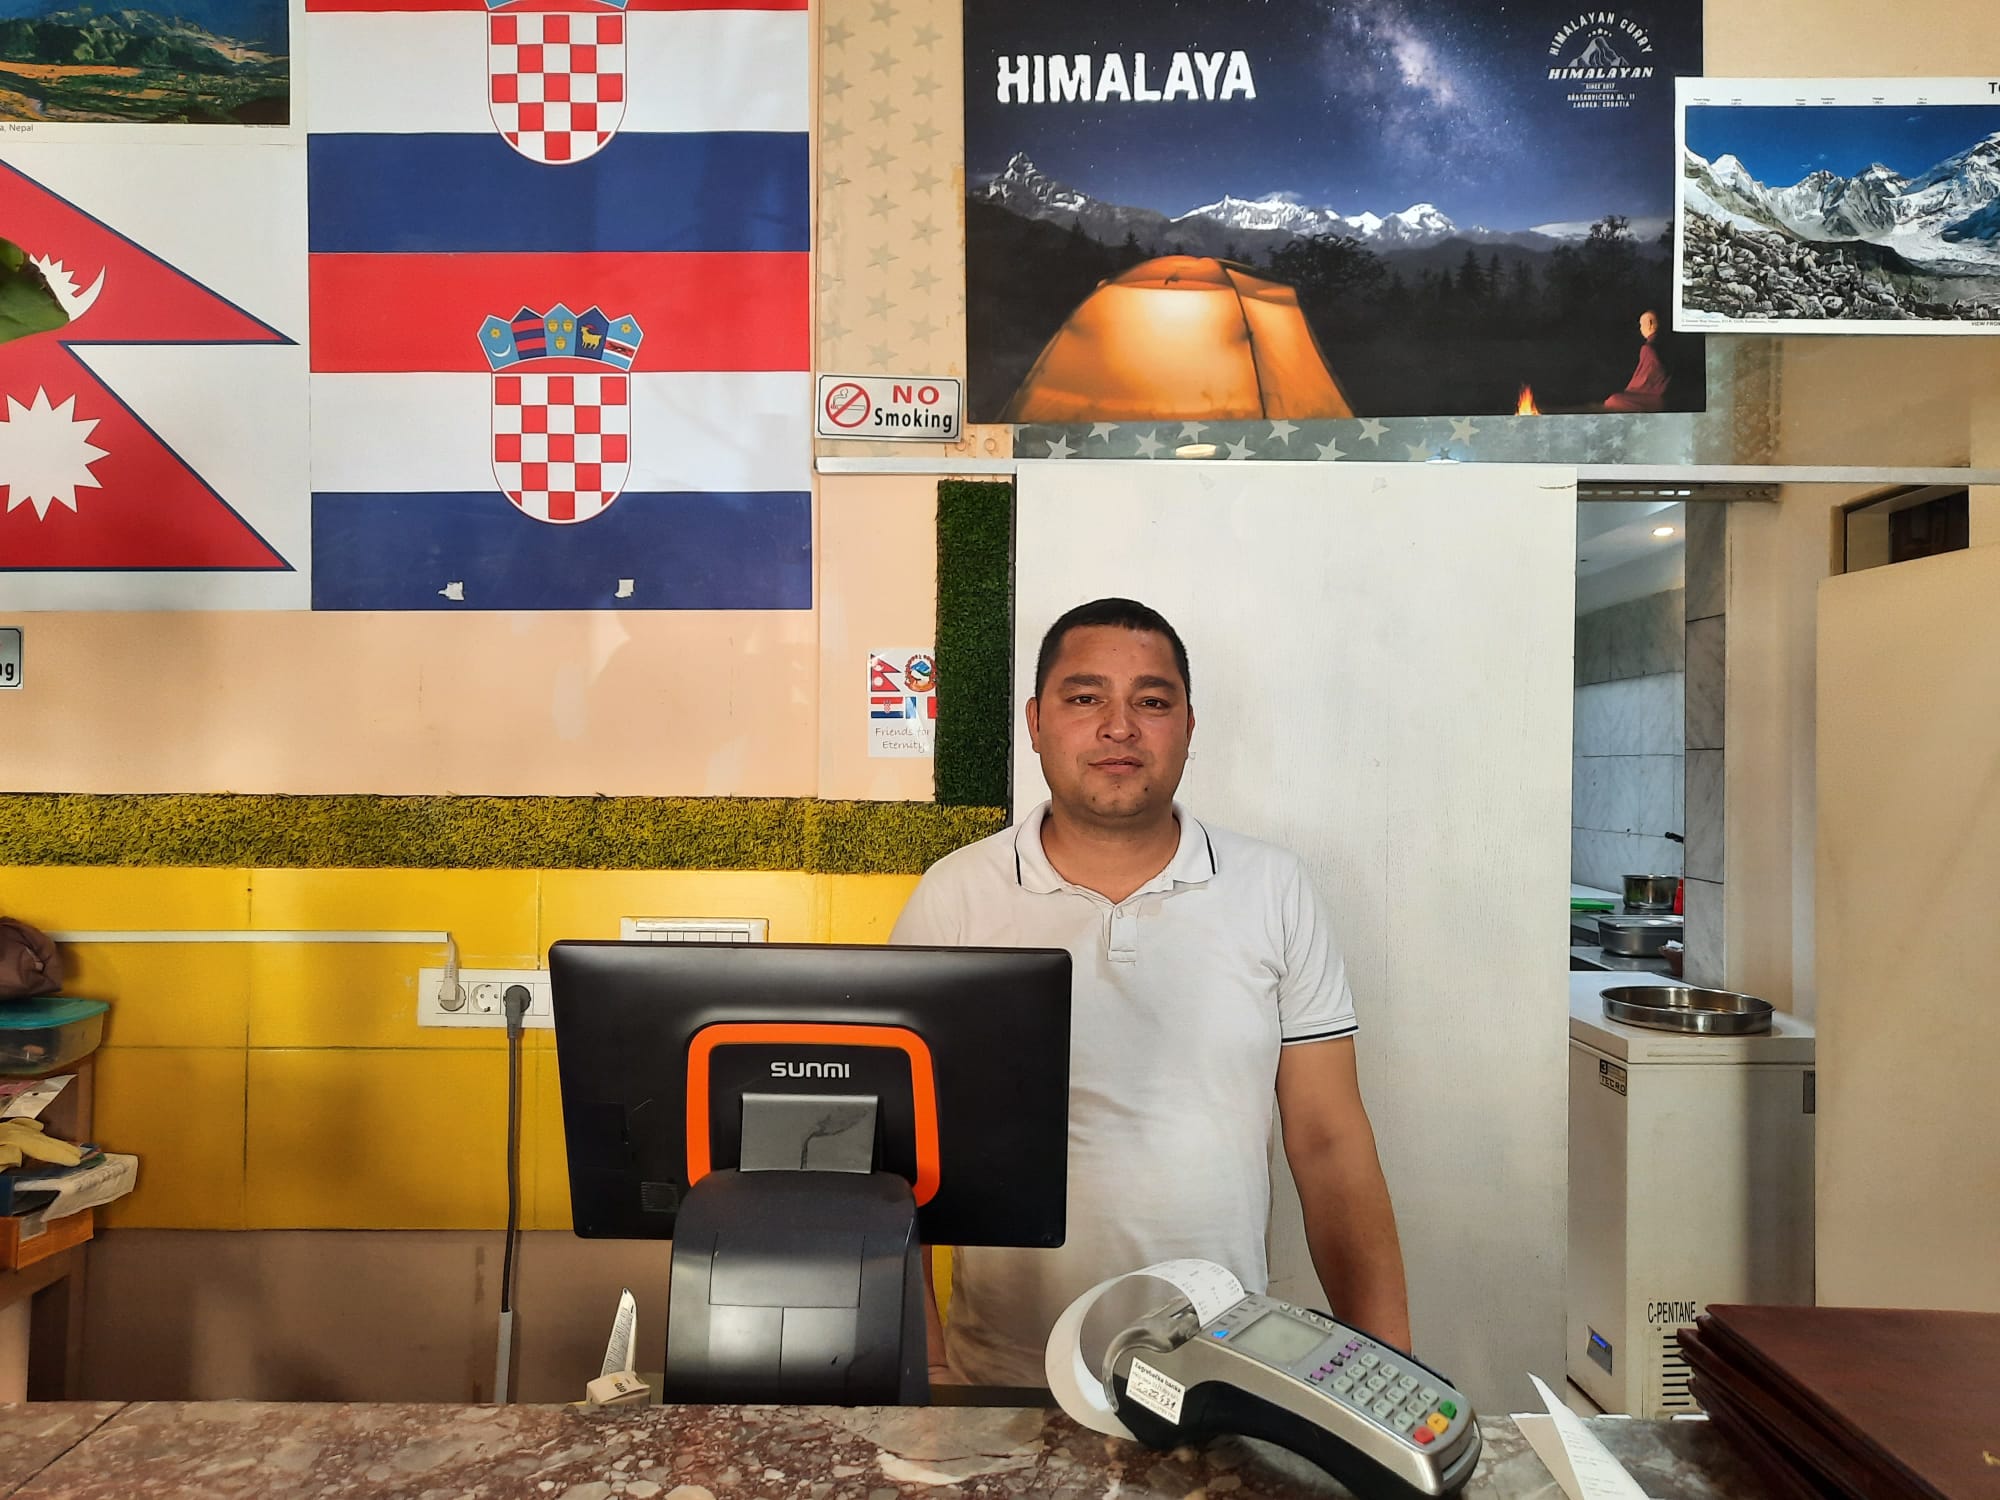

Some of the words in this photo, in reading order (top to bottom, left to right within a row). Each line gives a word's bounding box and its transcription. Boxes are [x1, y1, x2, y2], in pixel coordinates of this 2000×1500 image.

[1549, 11, 1615, 56] HIMALAYAN
[1619, 19, 1653, 53] CURRY
[997, 50, 1257, 104] HIMALAYA
[1548, 67, 1654, 79] HIMALAYAN
[9, 123, 34, 133] Nepal
[892, 384, 940, 405] NO
[874, 407, 953, 434] Smoking
[875, 727, 913, 737] Friends
[882, 740, 925, 753] Eternity
[770, 1061, 850, 1079] SUNMI
[1647, 1301, 1697, 1324] C-PENTANE
